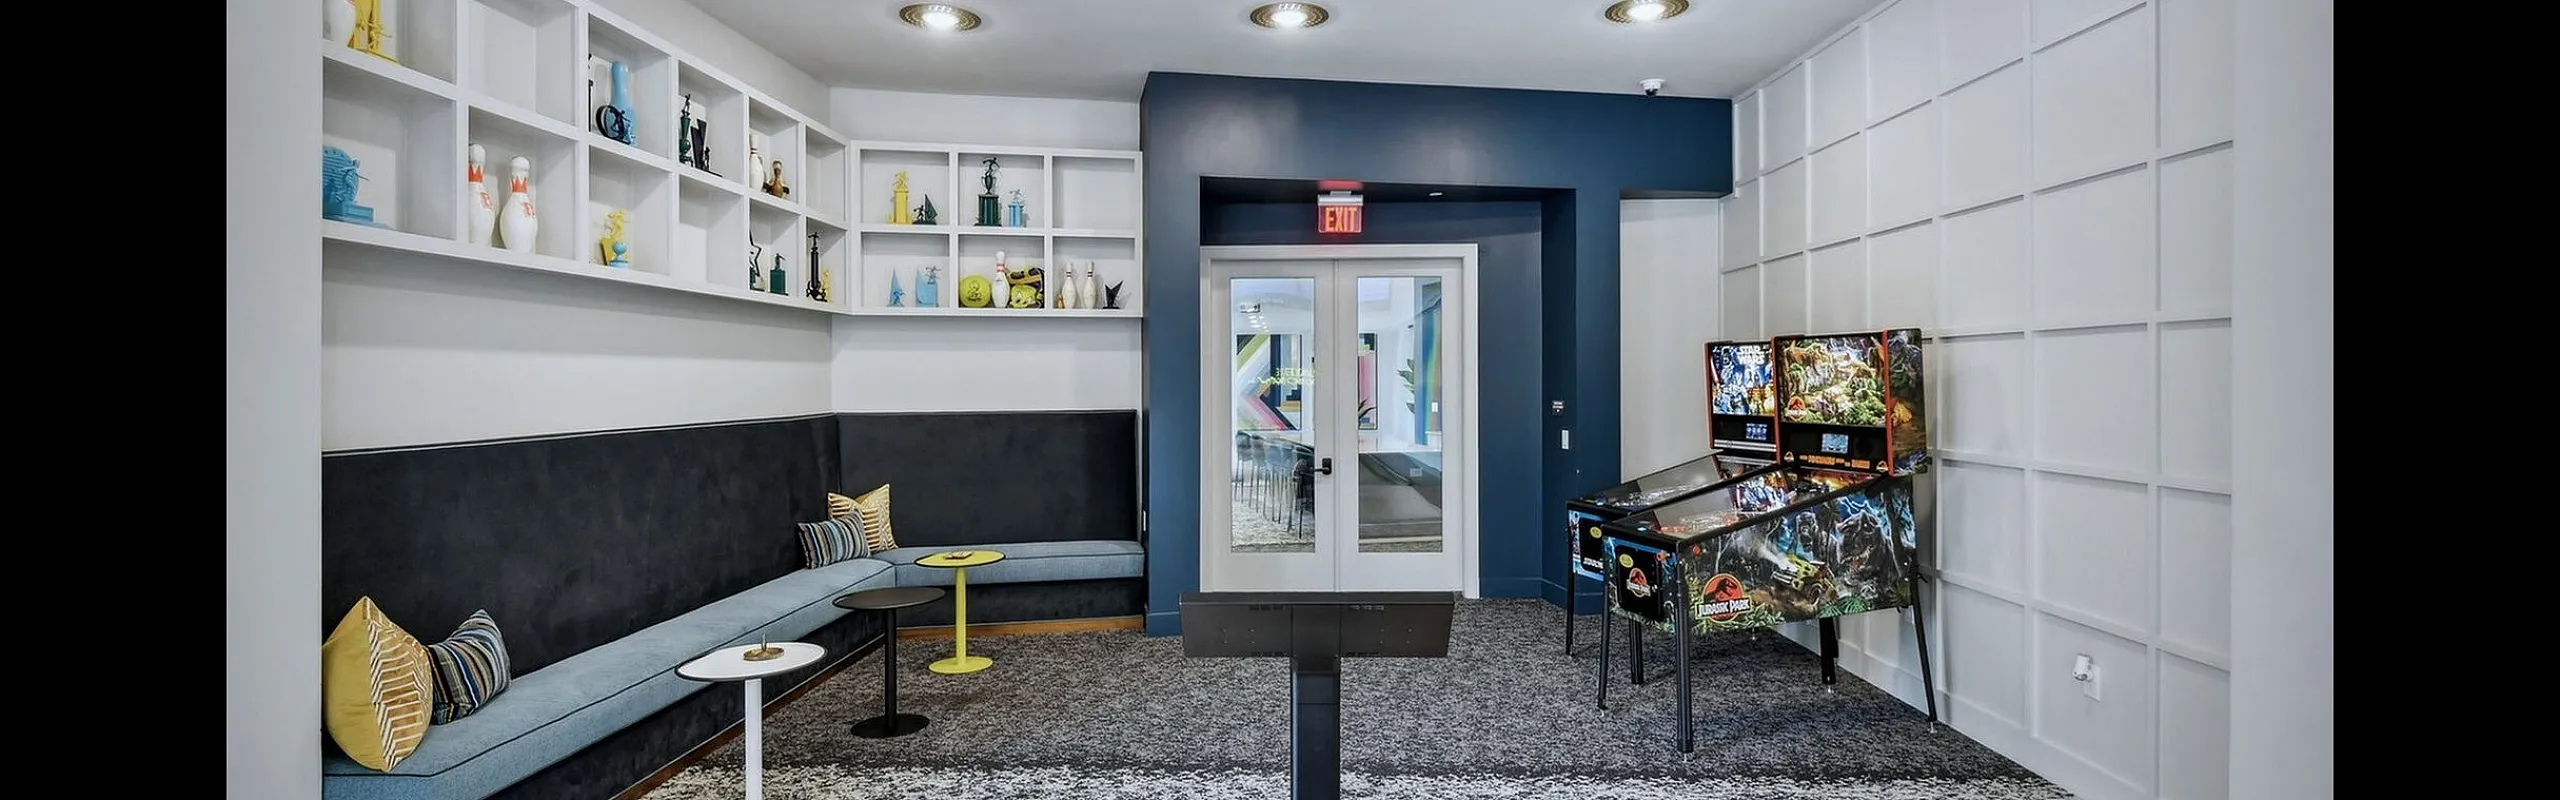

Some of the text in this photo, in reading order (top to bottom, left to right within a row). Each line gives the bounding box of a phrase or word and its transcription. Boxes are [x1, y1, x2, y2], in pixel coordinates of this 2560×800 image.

[1325, 206, 1357, 232] EXIT
[1739, 345, 1762, 353] STAR
[1739, 353, 1765, 365] WARS
[1698, 602, 1729, 617] JURASSIC
[1730, 599, 1750, 613] PARK
